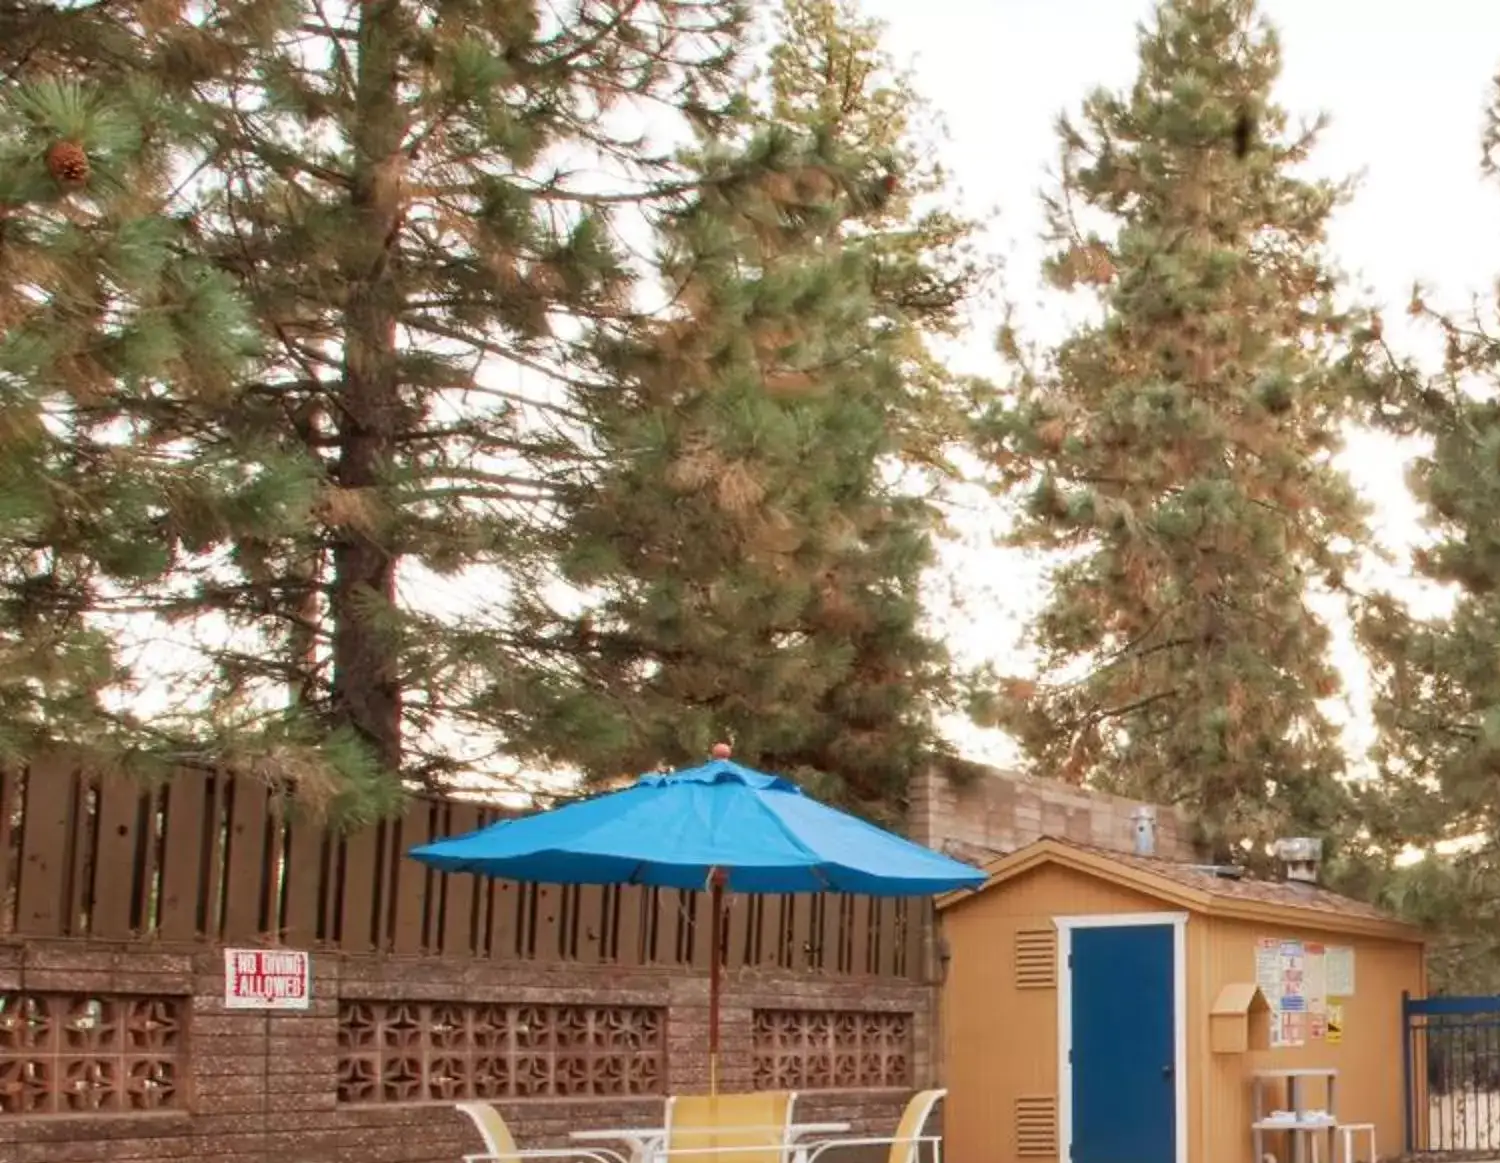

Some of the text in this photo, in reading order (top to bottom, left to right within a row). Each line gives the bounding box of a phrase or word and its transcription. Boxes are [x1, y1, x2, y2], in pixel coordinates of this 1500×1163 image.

[238, 953, 302, 975] NO DIVING
[239, 974, 302, 997] ALLOWED
